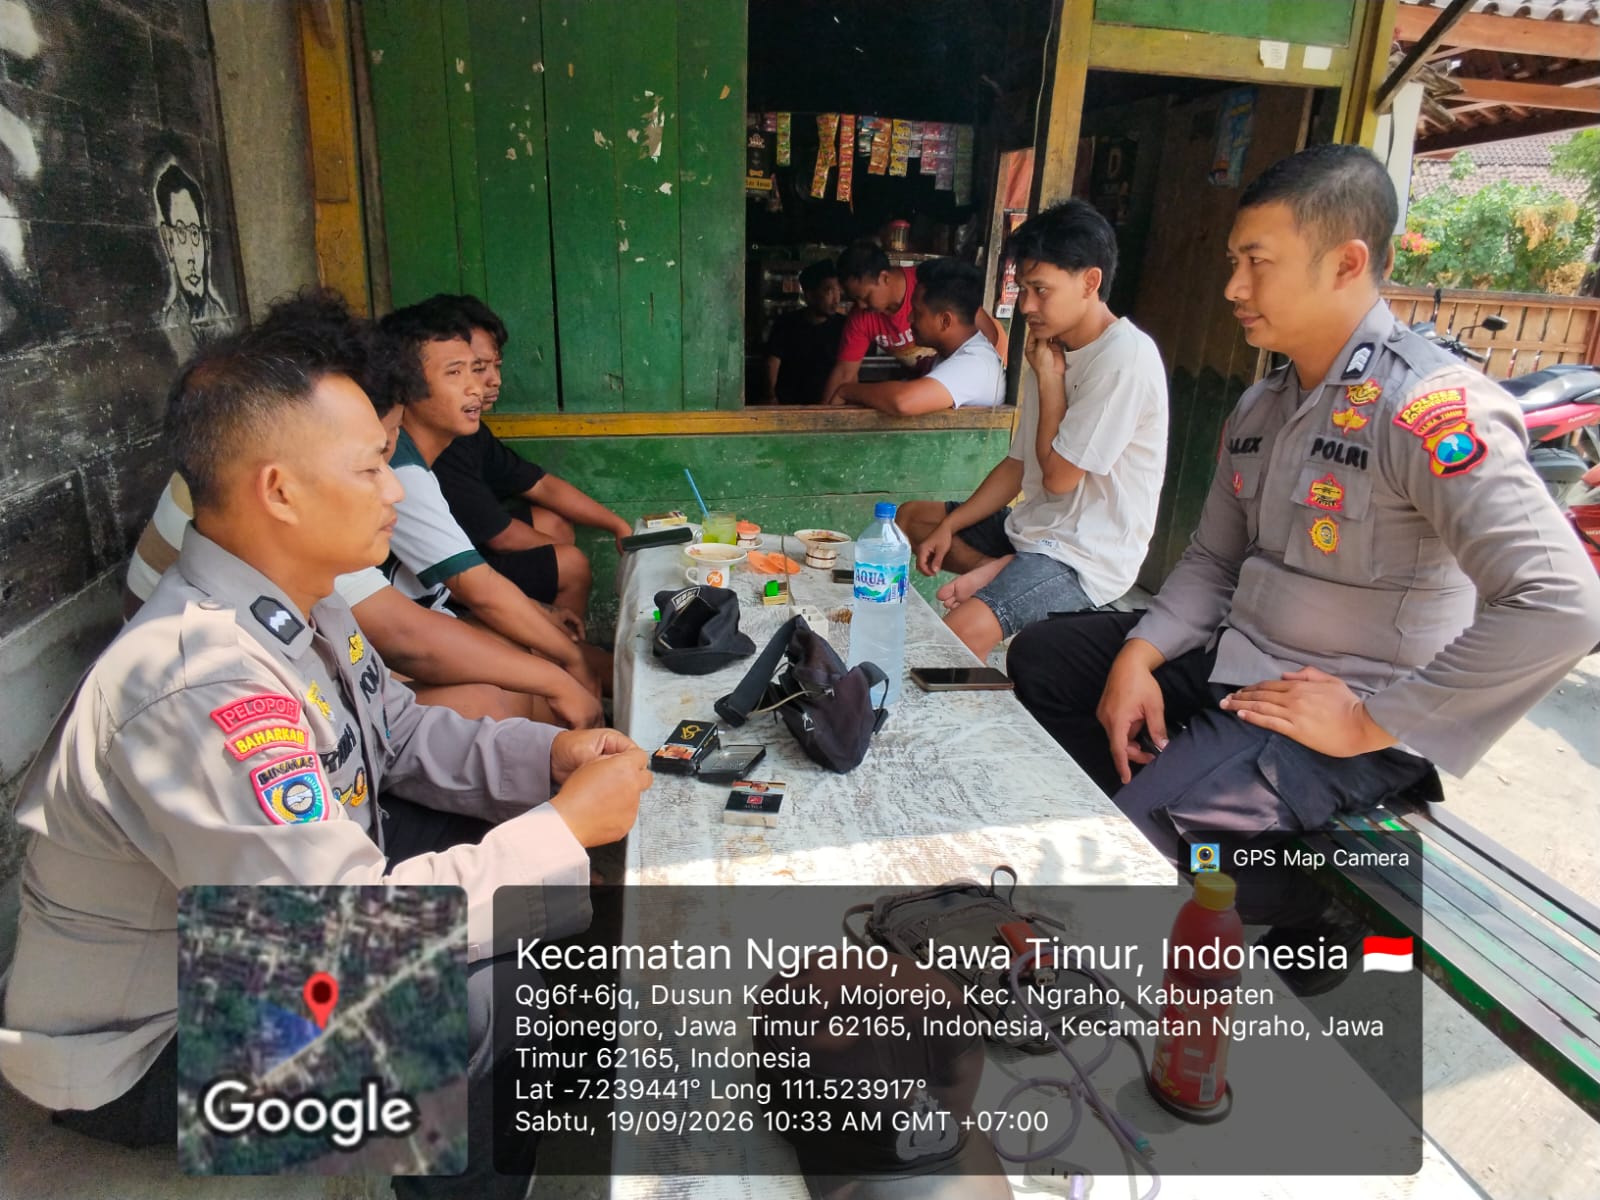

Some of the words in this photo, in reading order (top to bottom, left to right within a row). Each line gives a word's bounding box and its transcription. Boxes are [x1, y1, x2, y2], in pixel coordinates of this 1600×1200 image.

[1400, 388, 1462, 422] POLRES
[1310, 437, 1369, 470] POLRI
[856, 568, 886, 587] AQUA
[221, 697, 296, 727] PELOPOR
